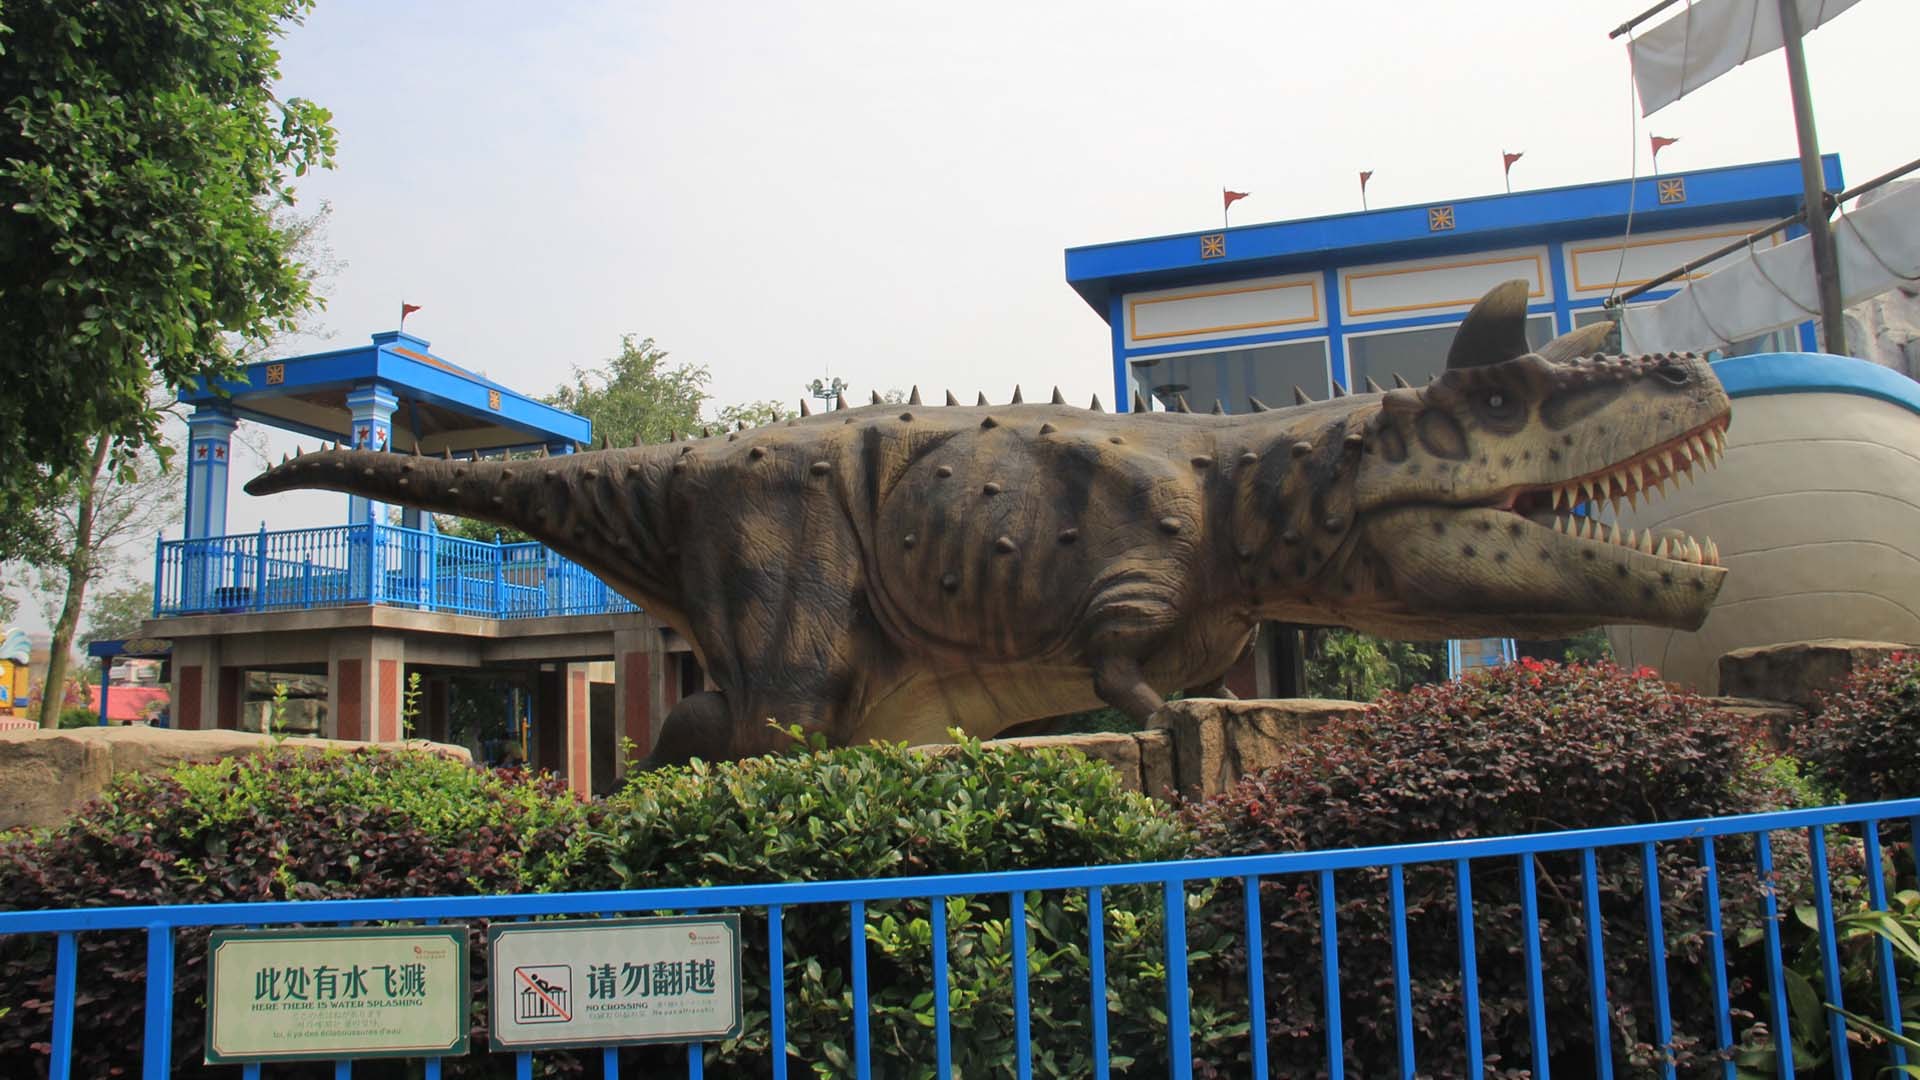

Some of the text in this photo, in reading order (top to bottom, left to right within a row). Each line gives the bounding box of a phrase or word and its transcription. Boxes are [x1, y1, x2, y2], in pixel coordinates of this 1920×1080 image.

[255, 963, 426, 1001] 此处有水飞溅
[586, 958, 716, 999] 请勿翻越
[251, 999, 423, 1011] HERE THERE IS WATER SPLASHING
[601, 1001, 648, 1011] CROSSING
